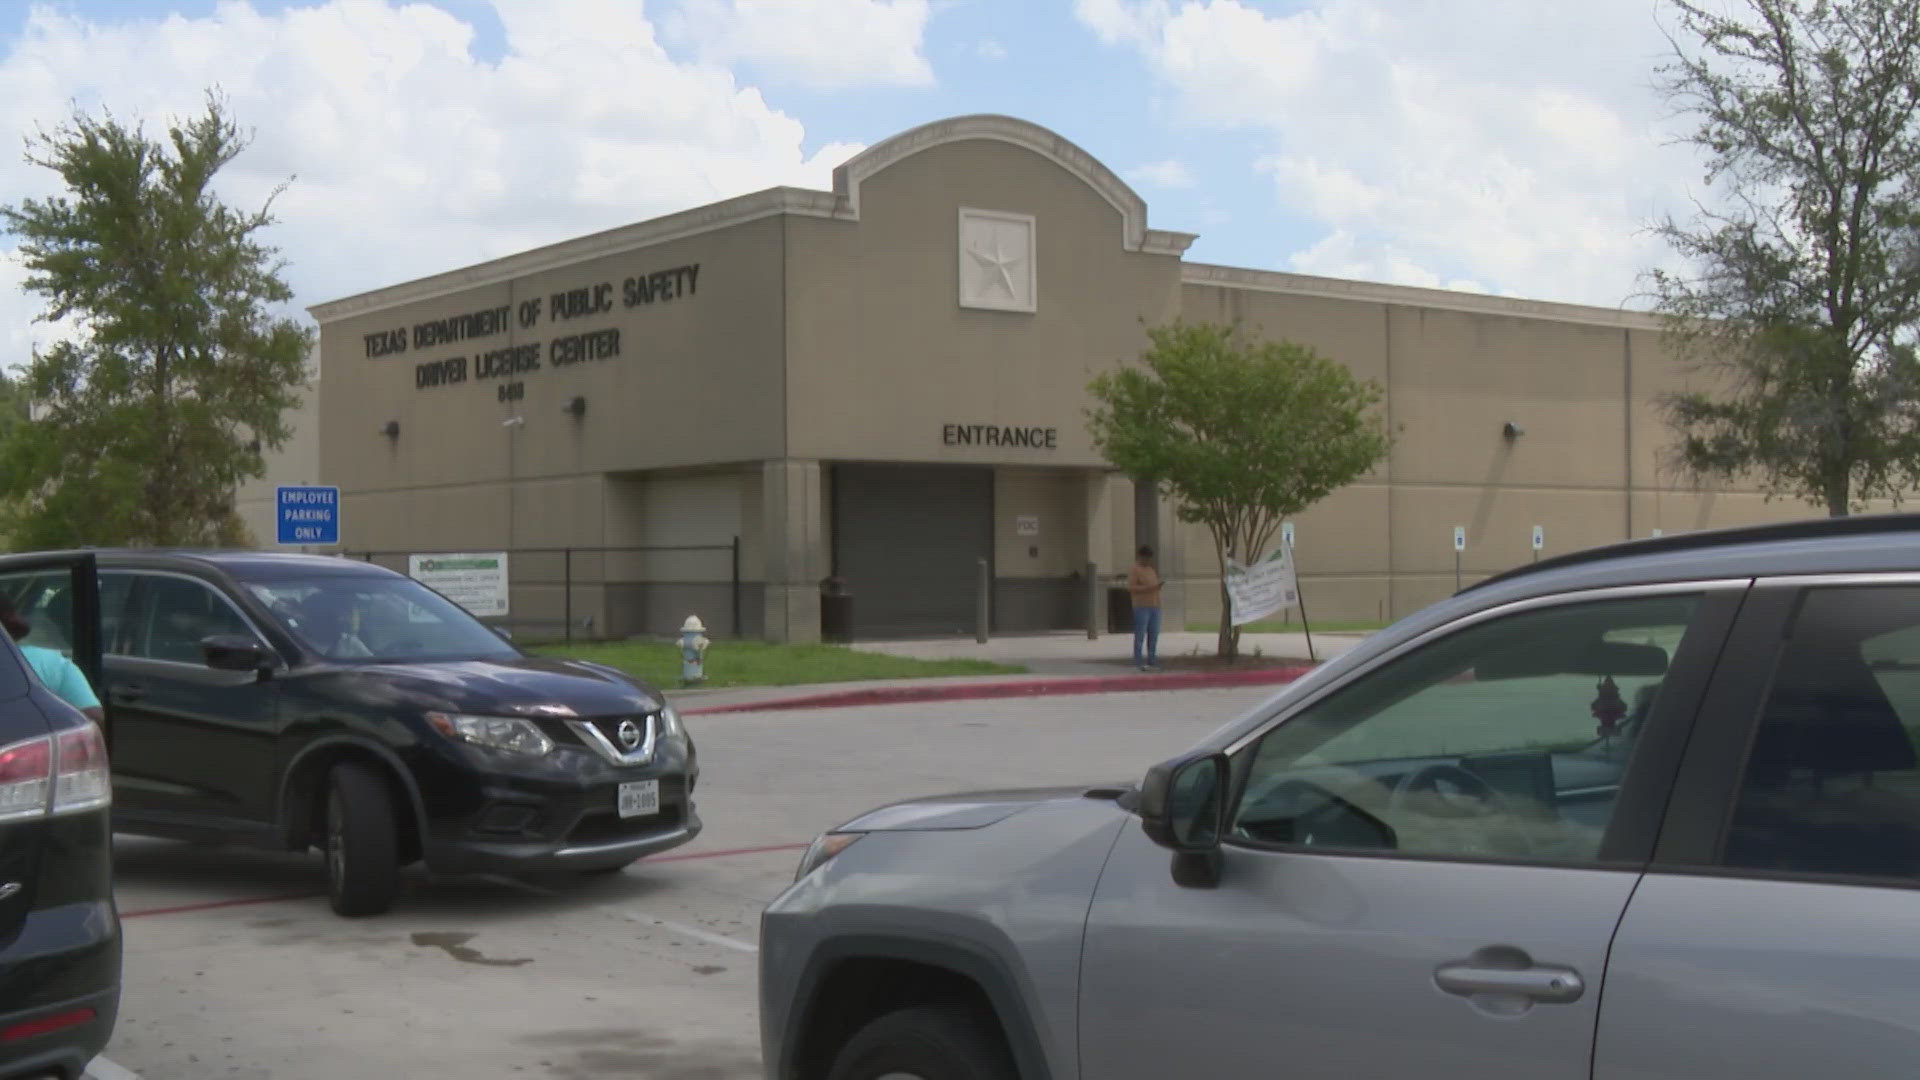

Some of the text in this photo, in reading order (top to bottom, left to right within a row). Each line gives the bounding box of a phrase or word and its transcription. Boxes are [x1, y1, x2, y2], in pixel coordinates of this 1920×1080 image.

[364, 263, 700, 358] TEXAS DEPARTMENT OF PUBLIC SAFETY
[416, 328, 621, 389] DRIVER LICENSE CENTER
[943, 424, 1057, 450] ENTRANCE
[281, 491, 334, 504] EMPLOYEE
[284, 509, 331, 521] PARKING
[294, 527, 322, 540] ONLY
